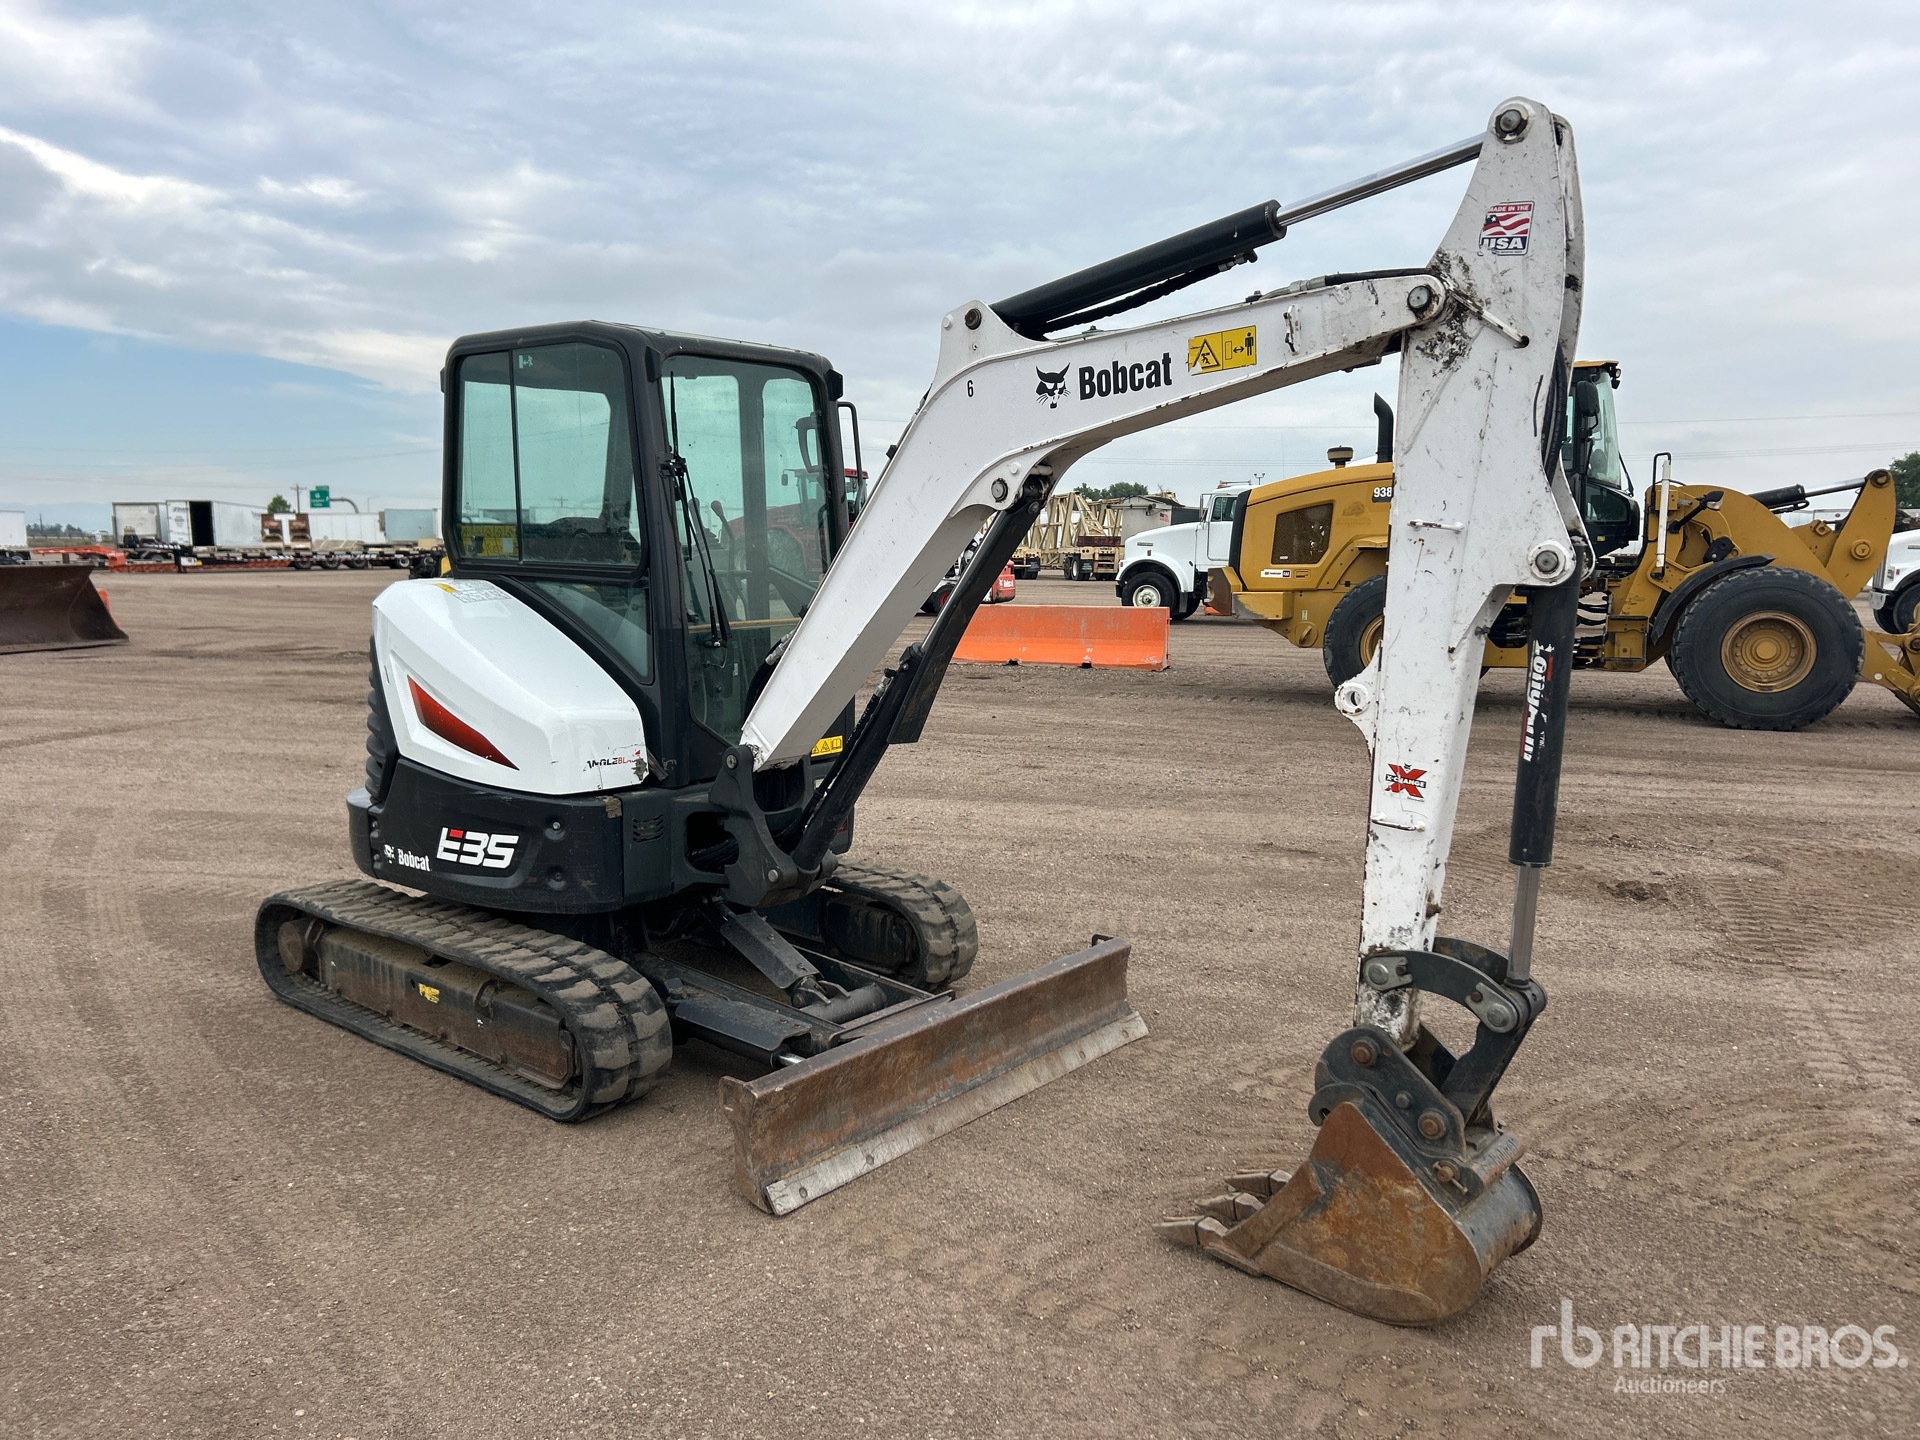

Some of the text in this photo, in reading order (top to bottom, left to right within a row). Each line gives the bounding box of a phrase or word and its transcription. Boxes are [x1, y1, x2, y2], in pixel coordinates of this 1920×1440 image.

[1482, 238, 1523, 249] USA
[1079, 352, 1172, 400] Bobcat
[966, 380, 974, 398] 6
[436, 826, 520, 869] E35
[397, 848, 431, 872] Bobcat
